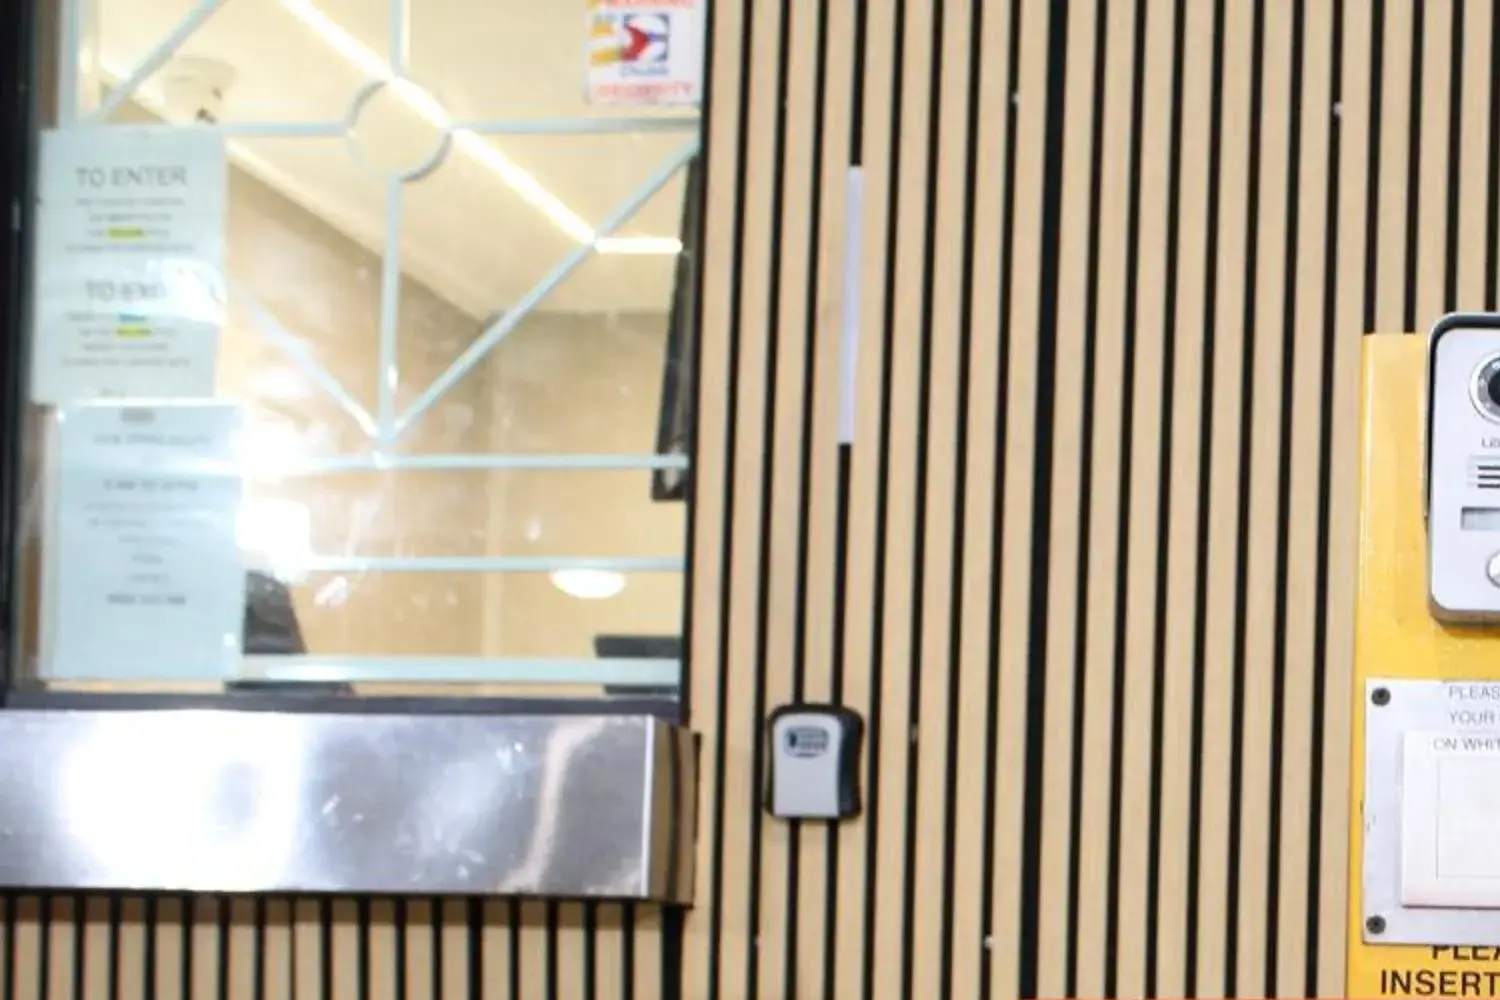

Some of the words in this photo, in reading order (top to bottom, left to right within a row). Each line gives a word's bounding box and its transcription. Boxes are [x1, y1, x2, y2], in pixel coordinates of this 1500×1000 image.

[76, 166, 106, 188] TO
[110, 166, 188, 188] ENTER
[1449, 710, 1496, 725] YOUR
[1433, 738, 1458, 751] ON
